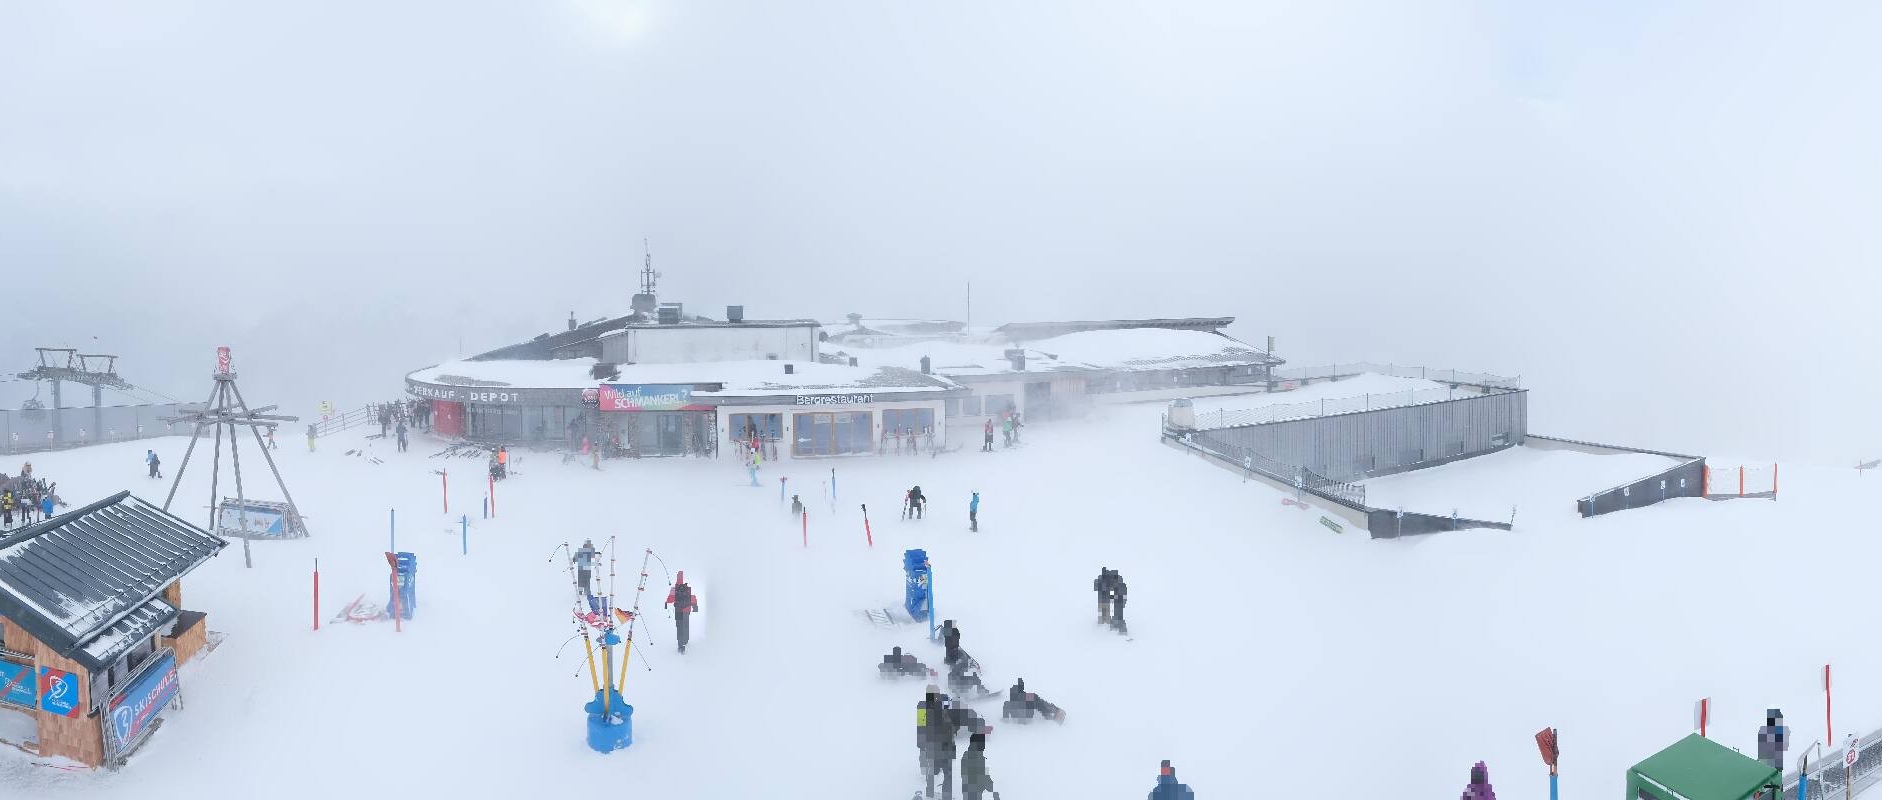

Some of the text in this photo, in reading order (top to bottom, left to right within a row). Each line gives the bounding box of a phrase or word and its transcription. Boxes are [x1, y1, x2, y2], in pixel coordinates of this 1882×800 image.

[414, 385, 455, 399] VERKAUF
[470, 392, 519, 402] DEPOT
[604, 386, 642, 399] Wild auf
[796, 393, 874, 405] Bergrestaurant
[134, 671, 175, 716] SKISCHULE
